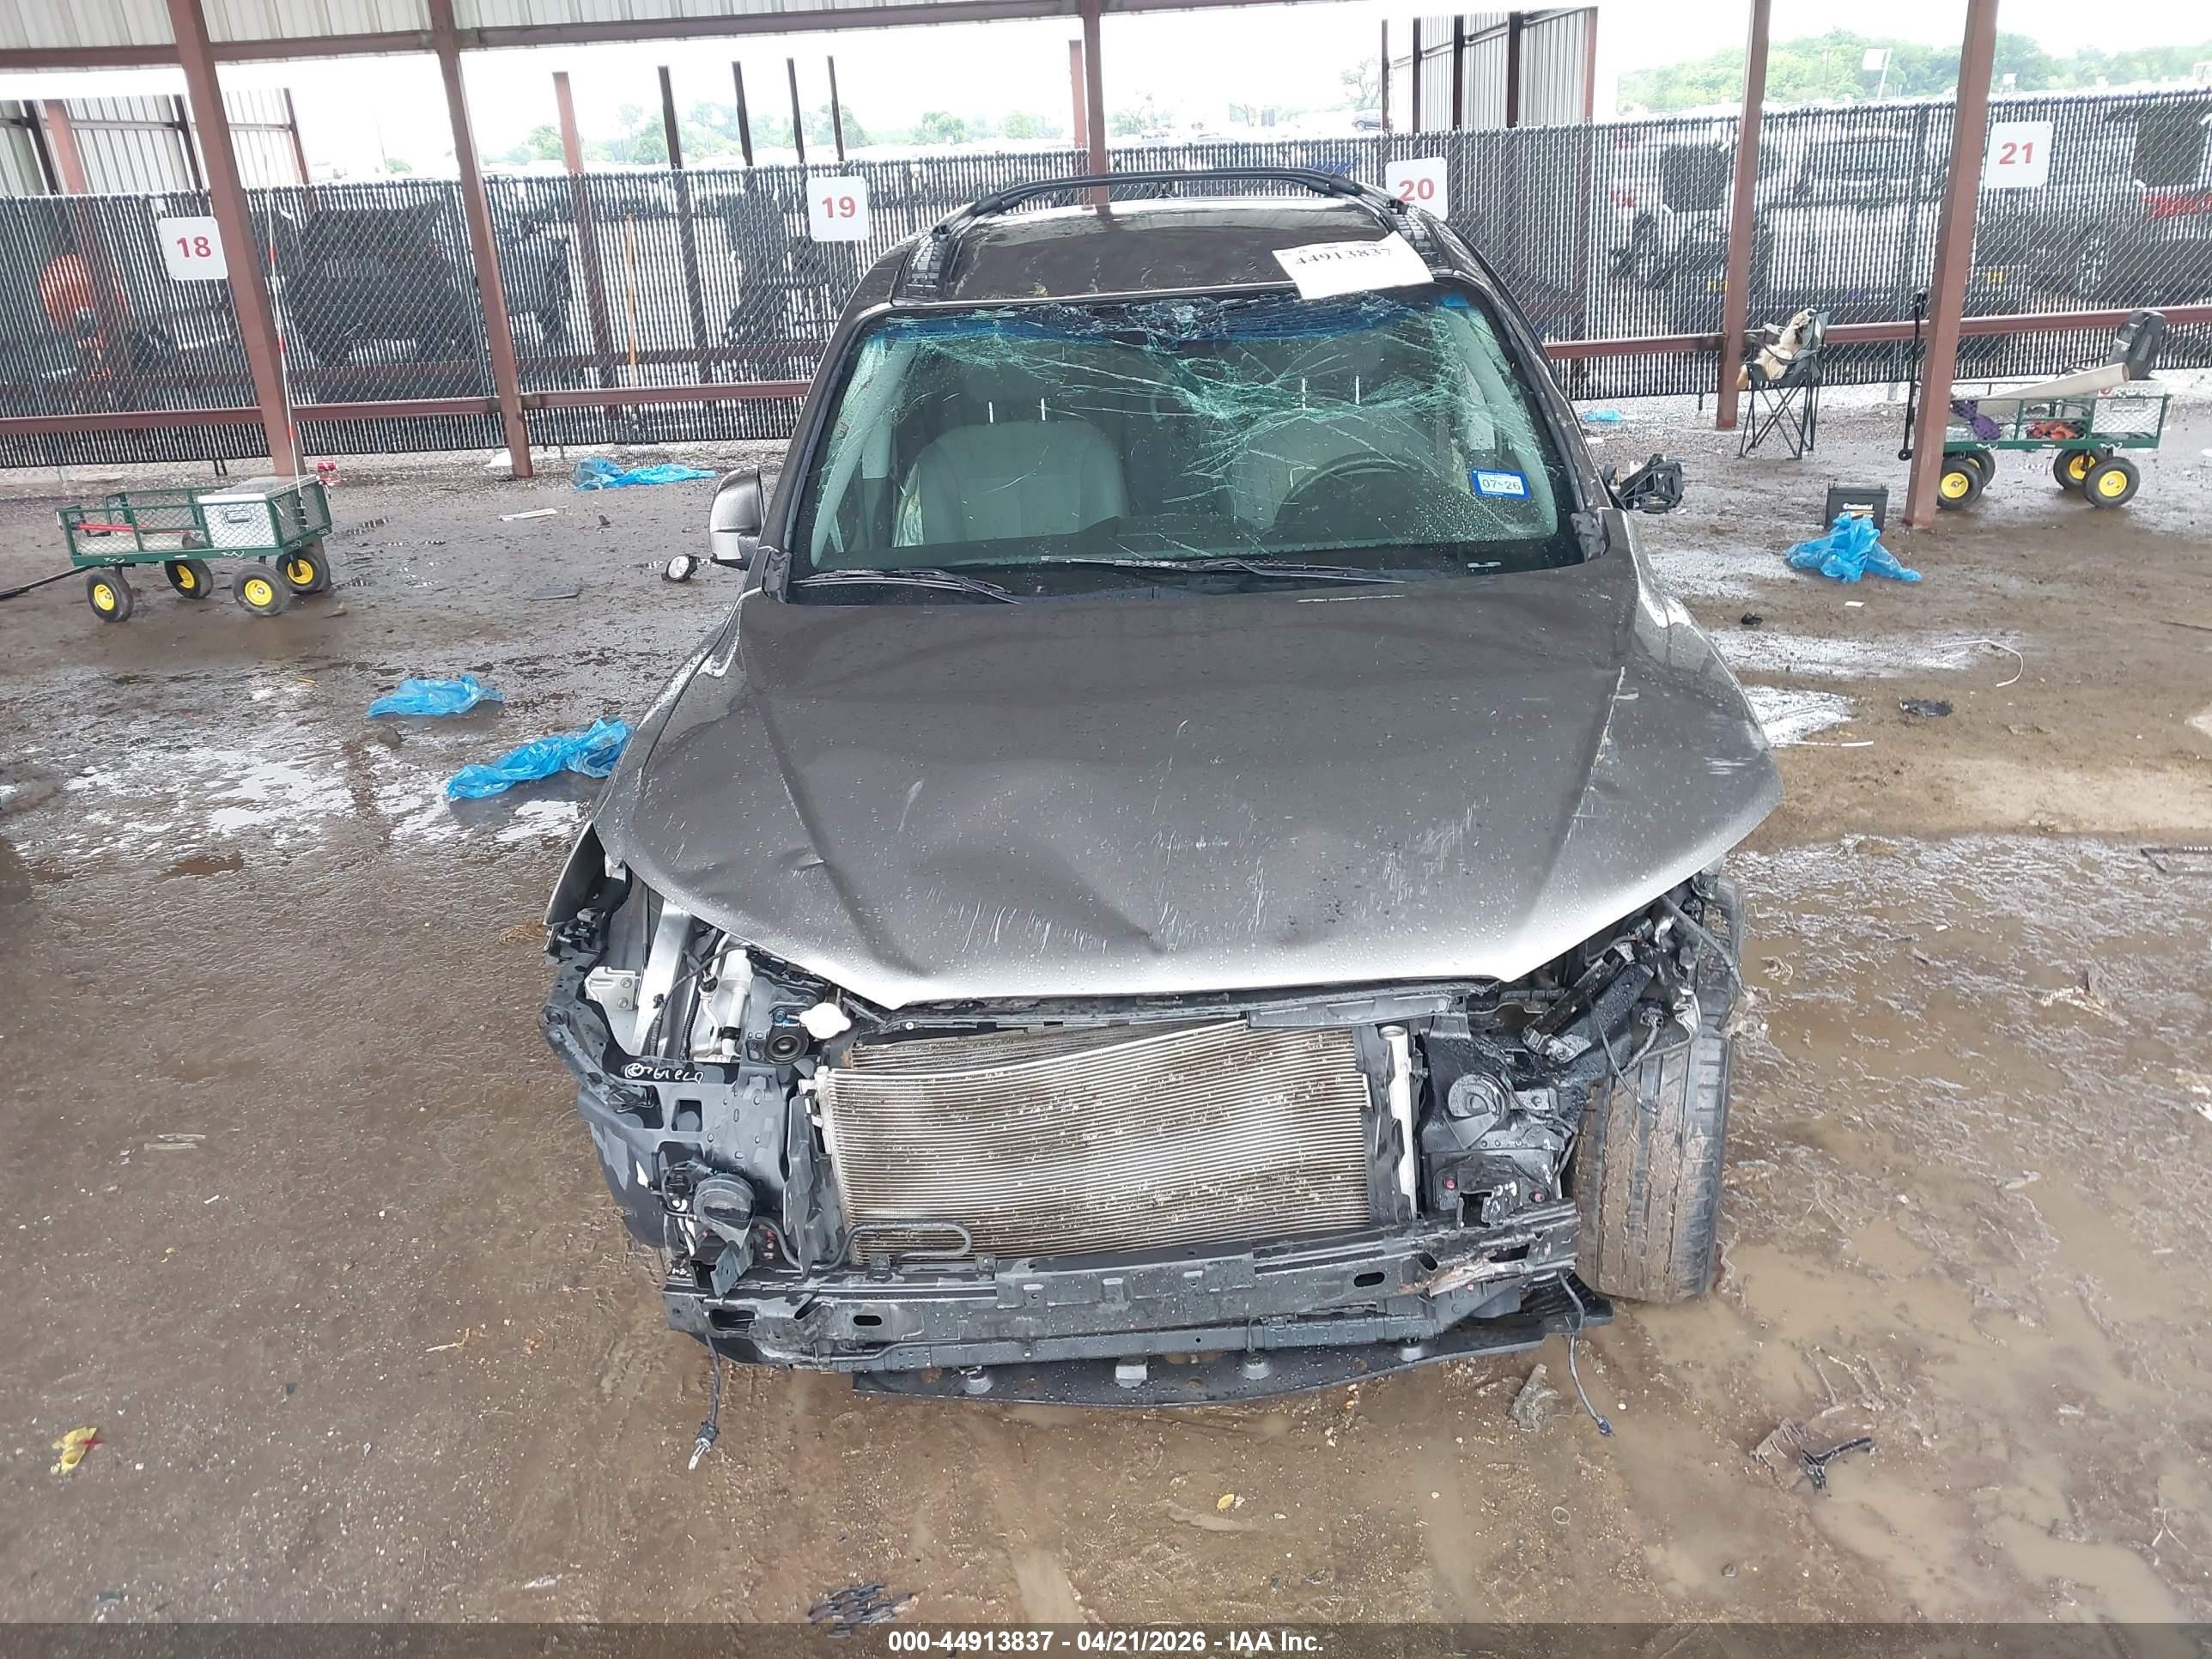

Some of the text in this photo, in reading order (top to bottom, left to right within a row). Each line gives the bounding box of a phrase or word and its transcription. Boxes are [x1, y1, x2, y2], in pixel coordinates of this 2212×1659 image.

[1999, 142, 2034, 165] 21
[1398, 178, 1435, 202] 20
[822, 196, 856, 219] 19
[176, 236, 211, 258] 18
[1295, 247, 1391, 264] 44913837
